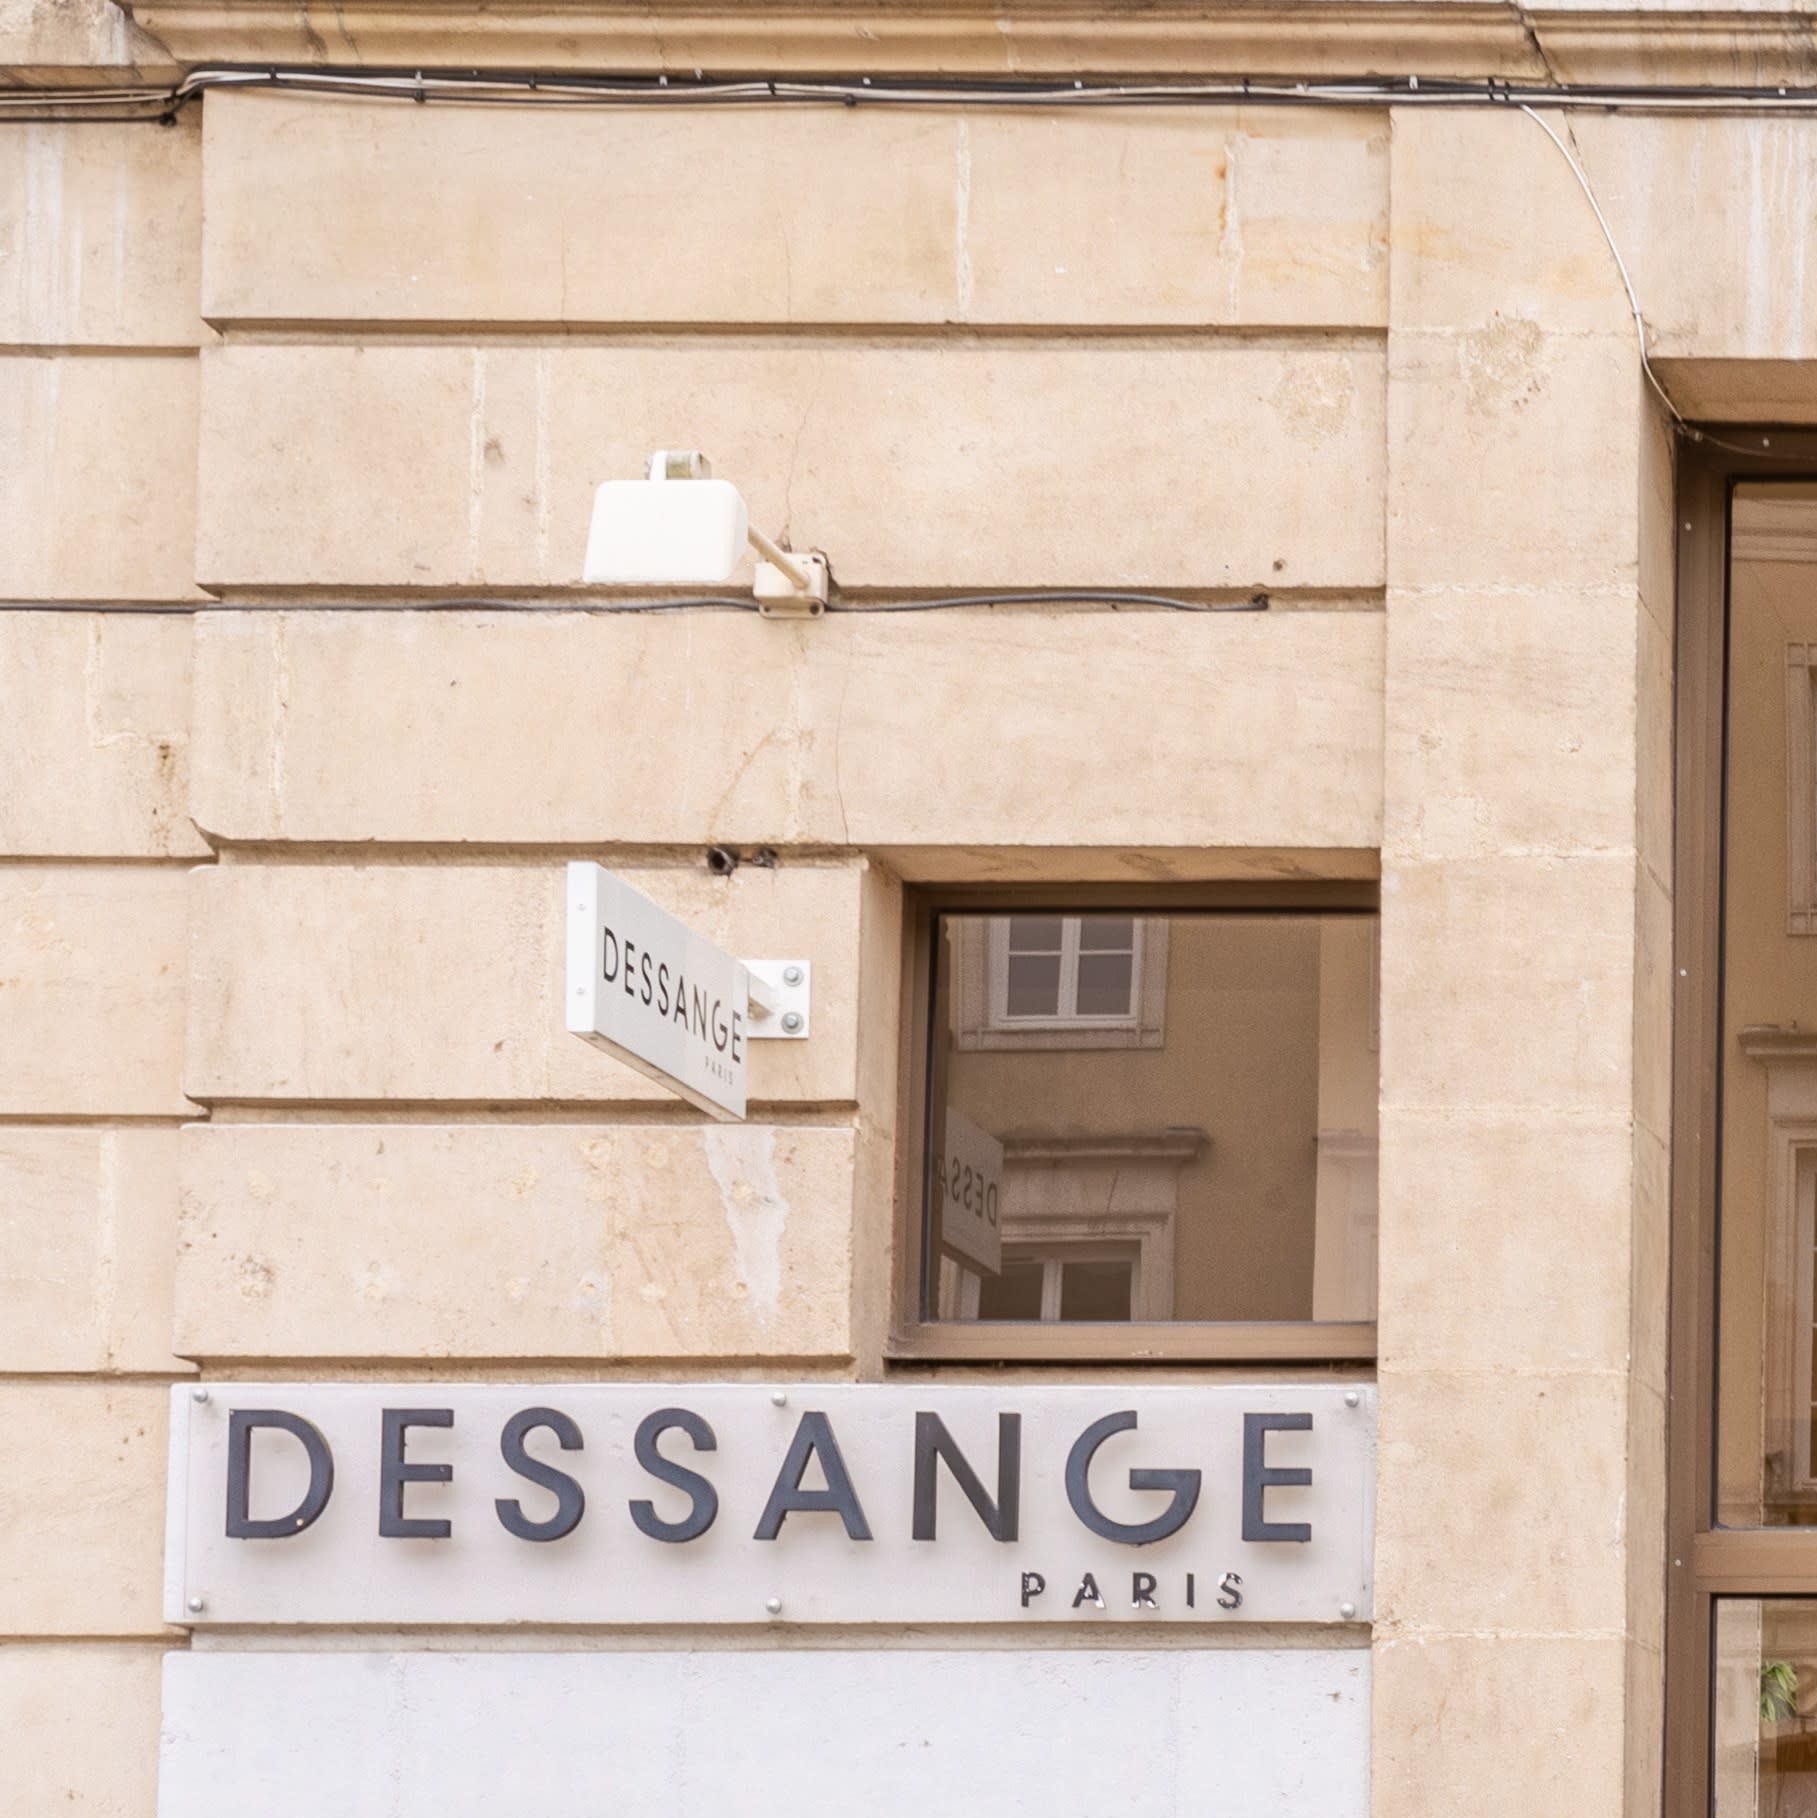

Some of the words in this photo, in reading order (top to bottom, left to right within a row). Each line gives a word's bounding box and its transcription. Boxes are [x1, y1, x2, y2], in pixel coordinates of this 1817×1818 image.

[602, 926, 742, 1064] DESSANGE
[704, 1058, 734, 1086] PARIS
[226, 1407, 1313, 1544] DESSANGE
[1019, 1571, 1245, 1610] PARIS
